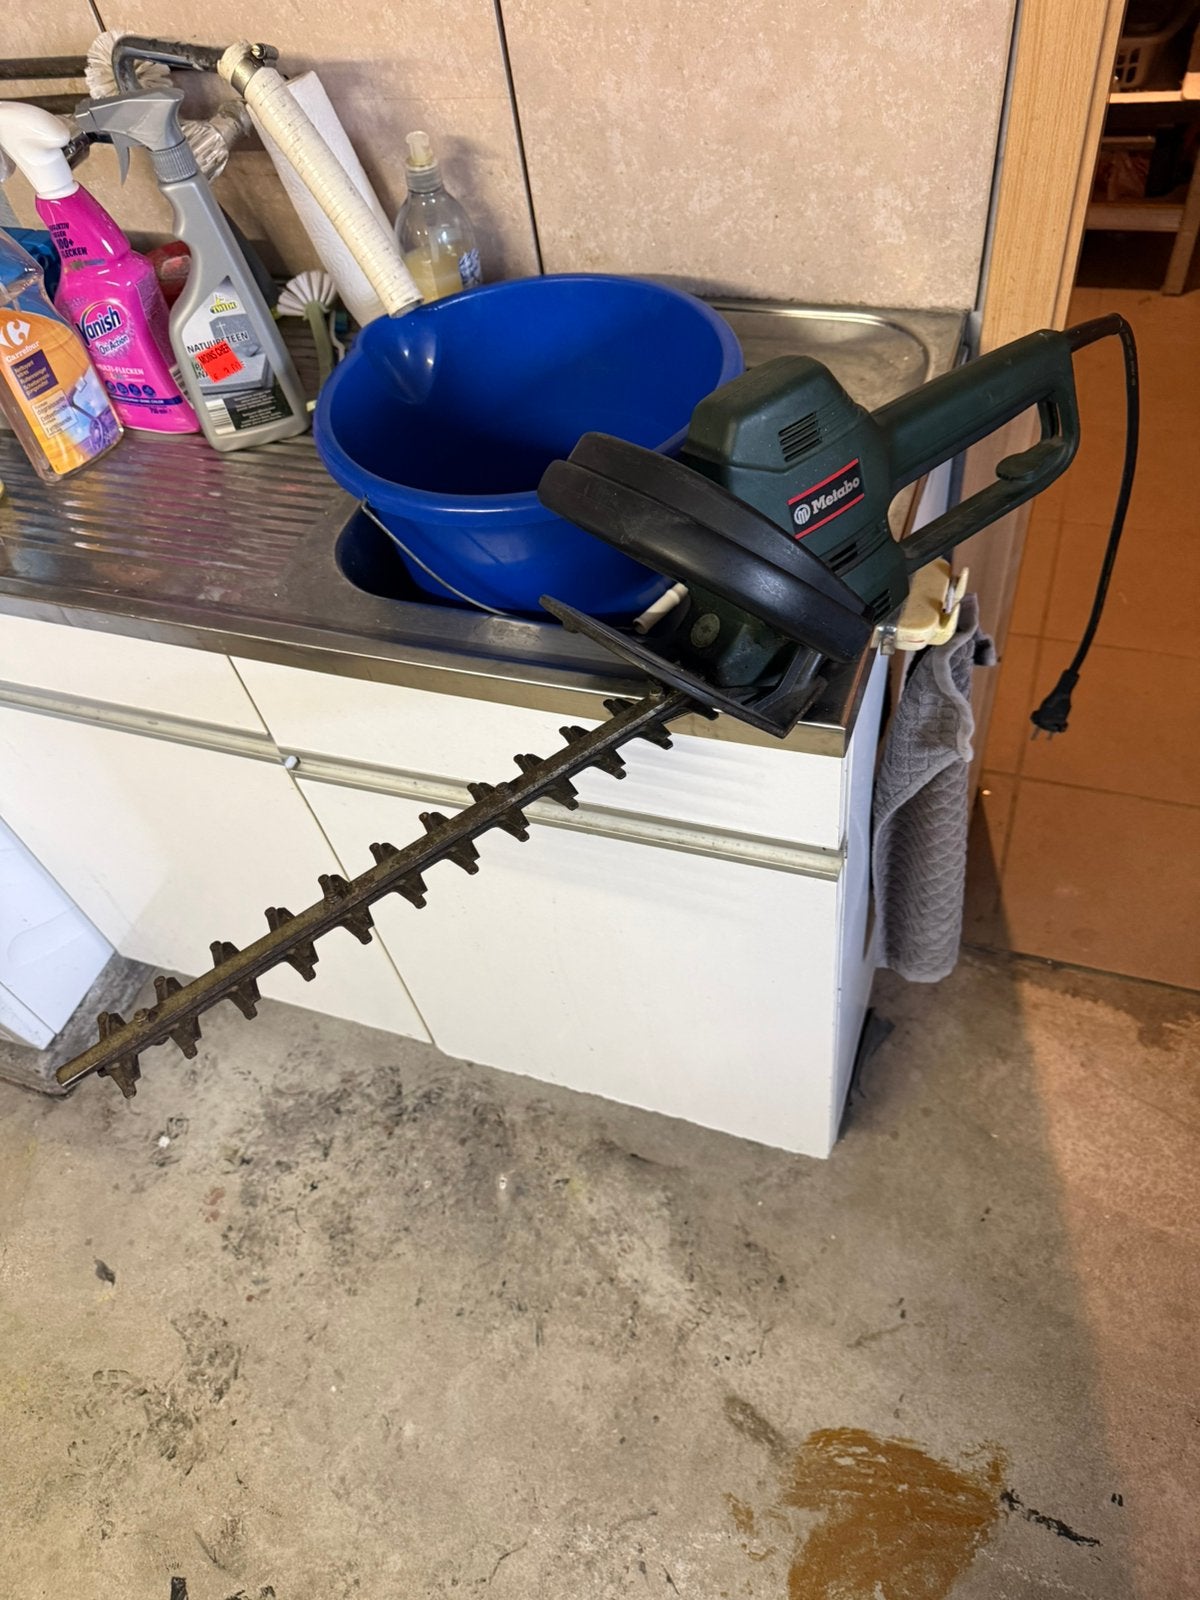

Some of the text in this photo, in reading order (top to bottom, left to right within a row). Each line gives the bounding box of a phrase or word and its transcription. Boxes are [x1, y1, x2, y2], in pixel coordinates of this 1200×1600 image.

[75, 306, 121, 346] Vanish
[5, 340, 40, 362] Carrefour
[811, 477, 860, 515] Metabo
